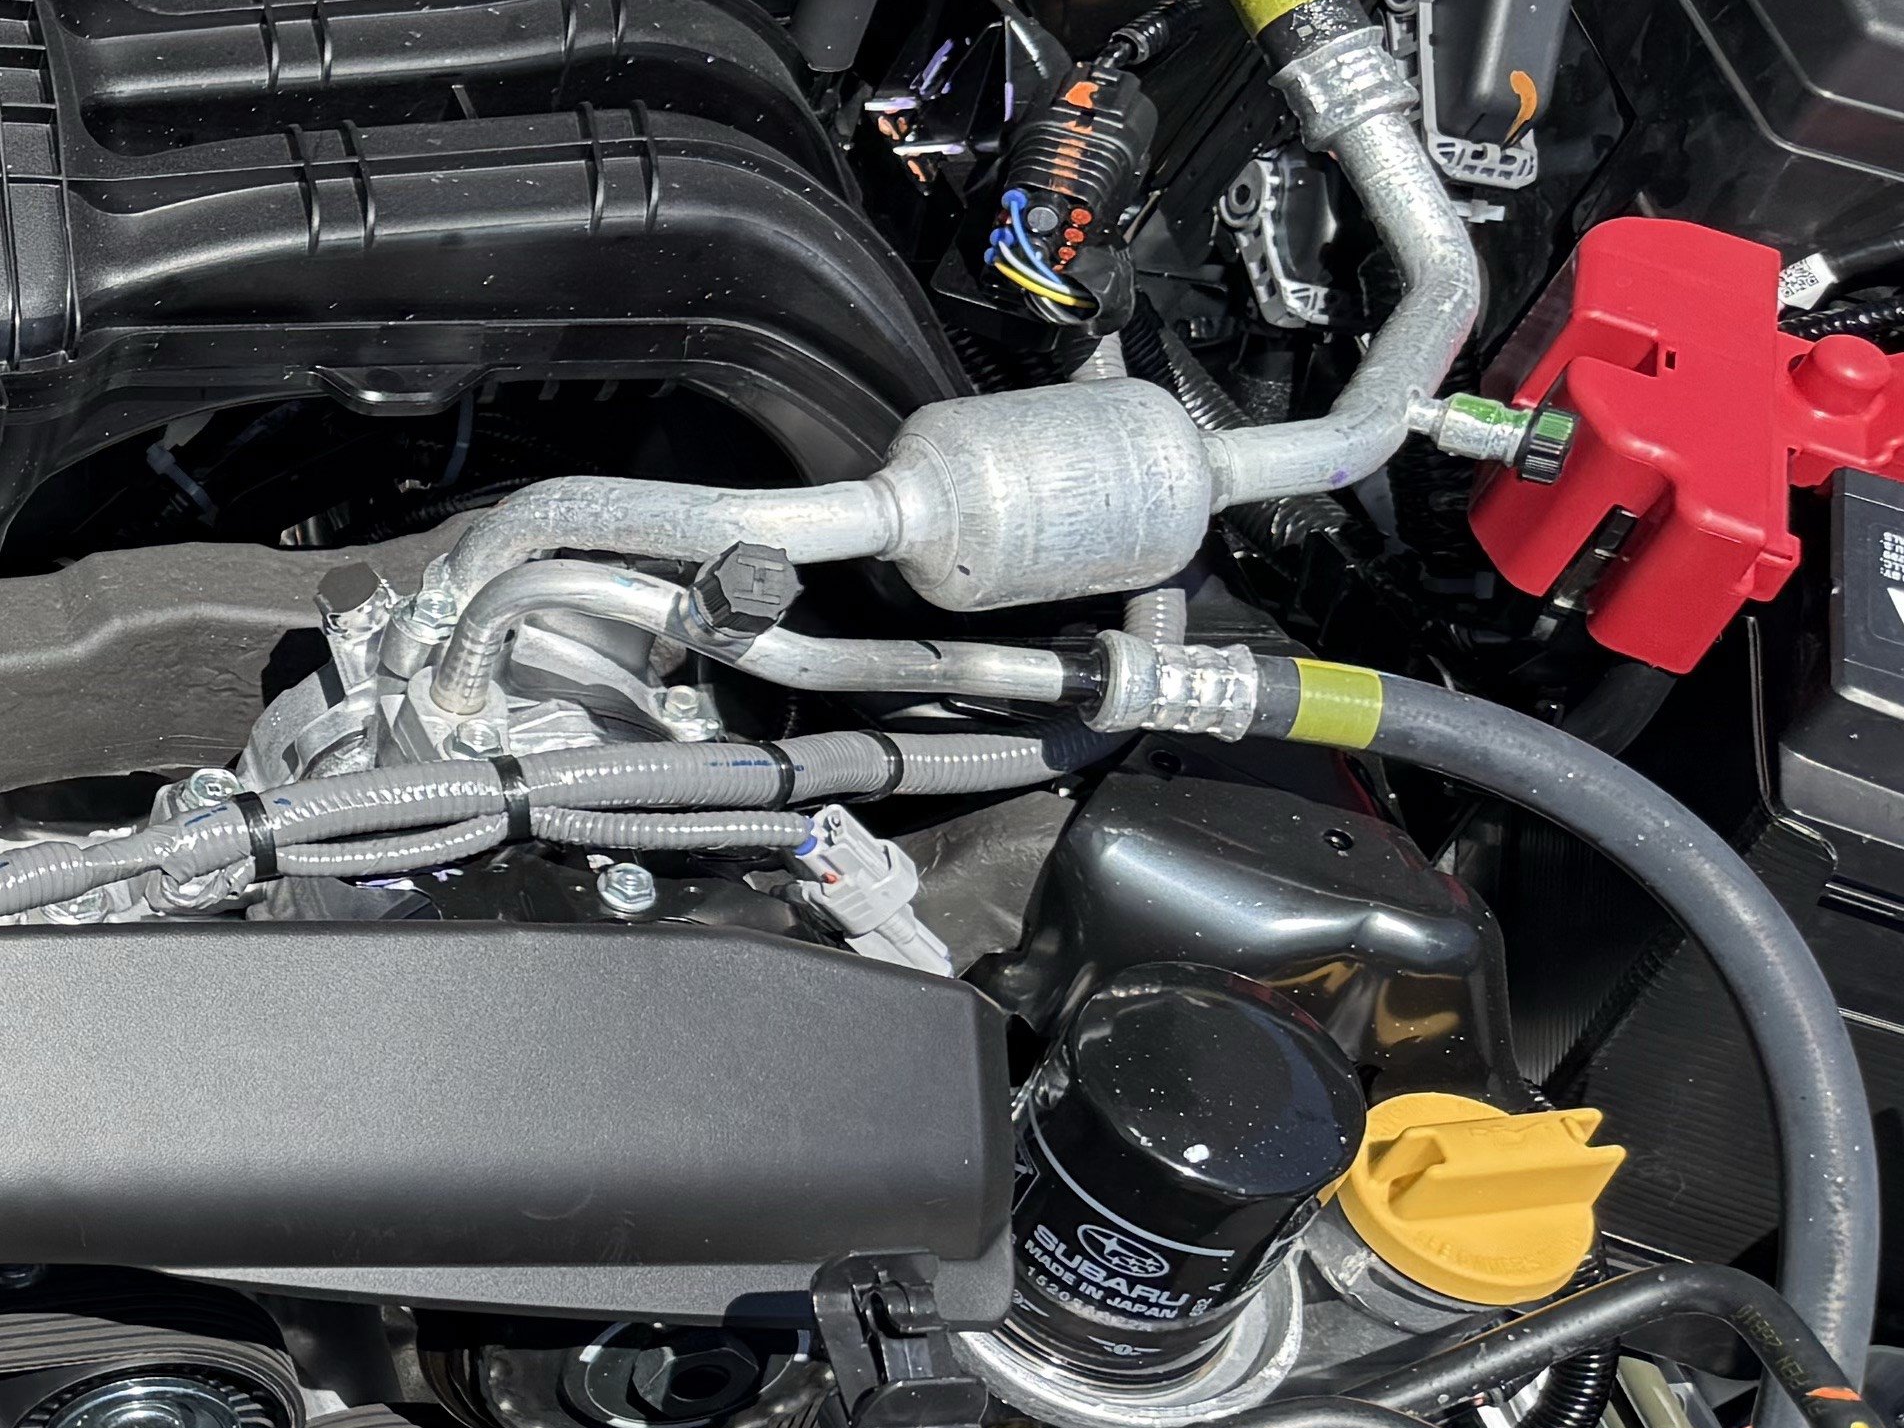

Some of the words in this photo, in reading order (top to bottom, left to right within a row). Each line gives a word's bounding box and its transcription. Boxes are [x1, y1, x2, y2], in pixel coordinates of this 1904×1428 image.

[1024, 1239, 1077, 1285] MADE
[1079, 1281, 1104, 1300] IN
[1106, 1296, 1179, 1319] JAPAN
[1034, 1224, 1190, 1306] SUBARU
